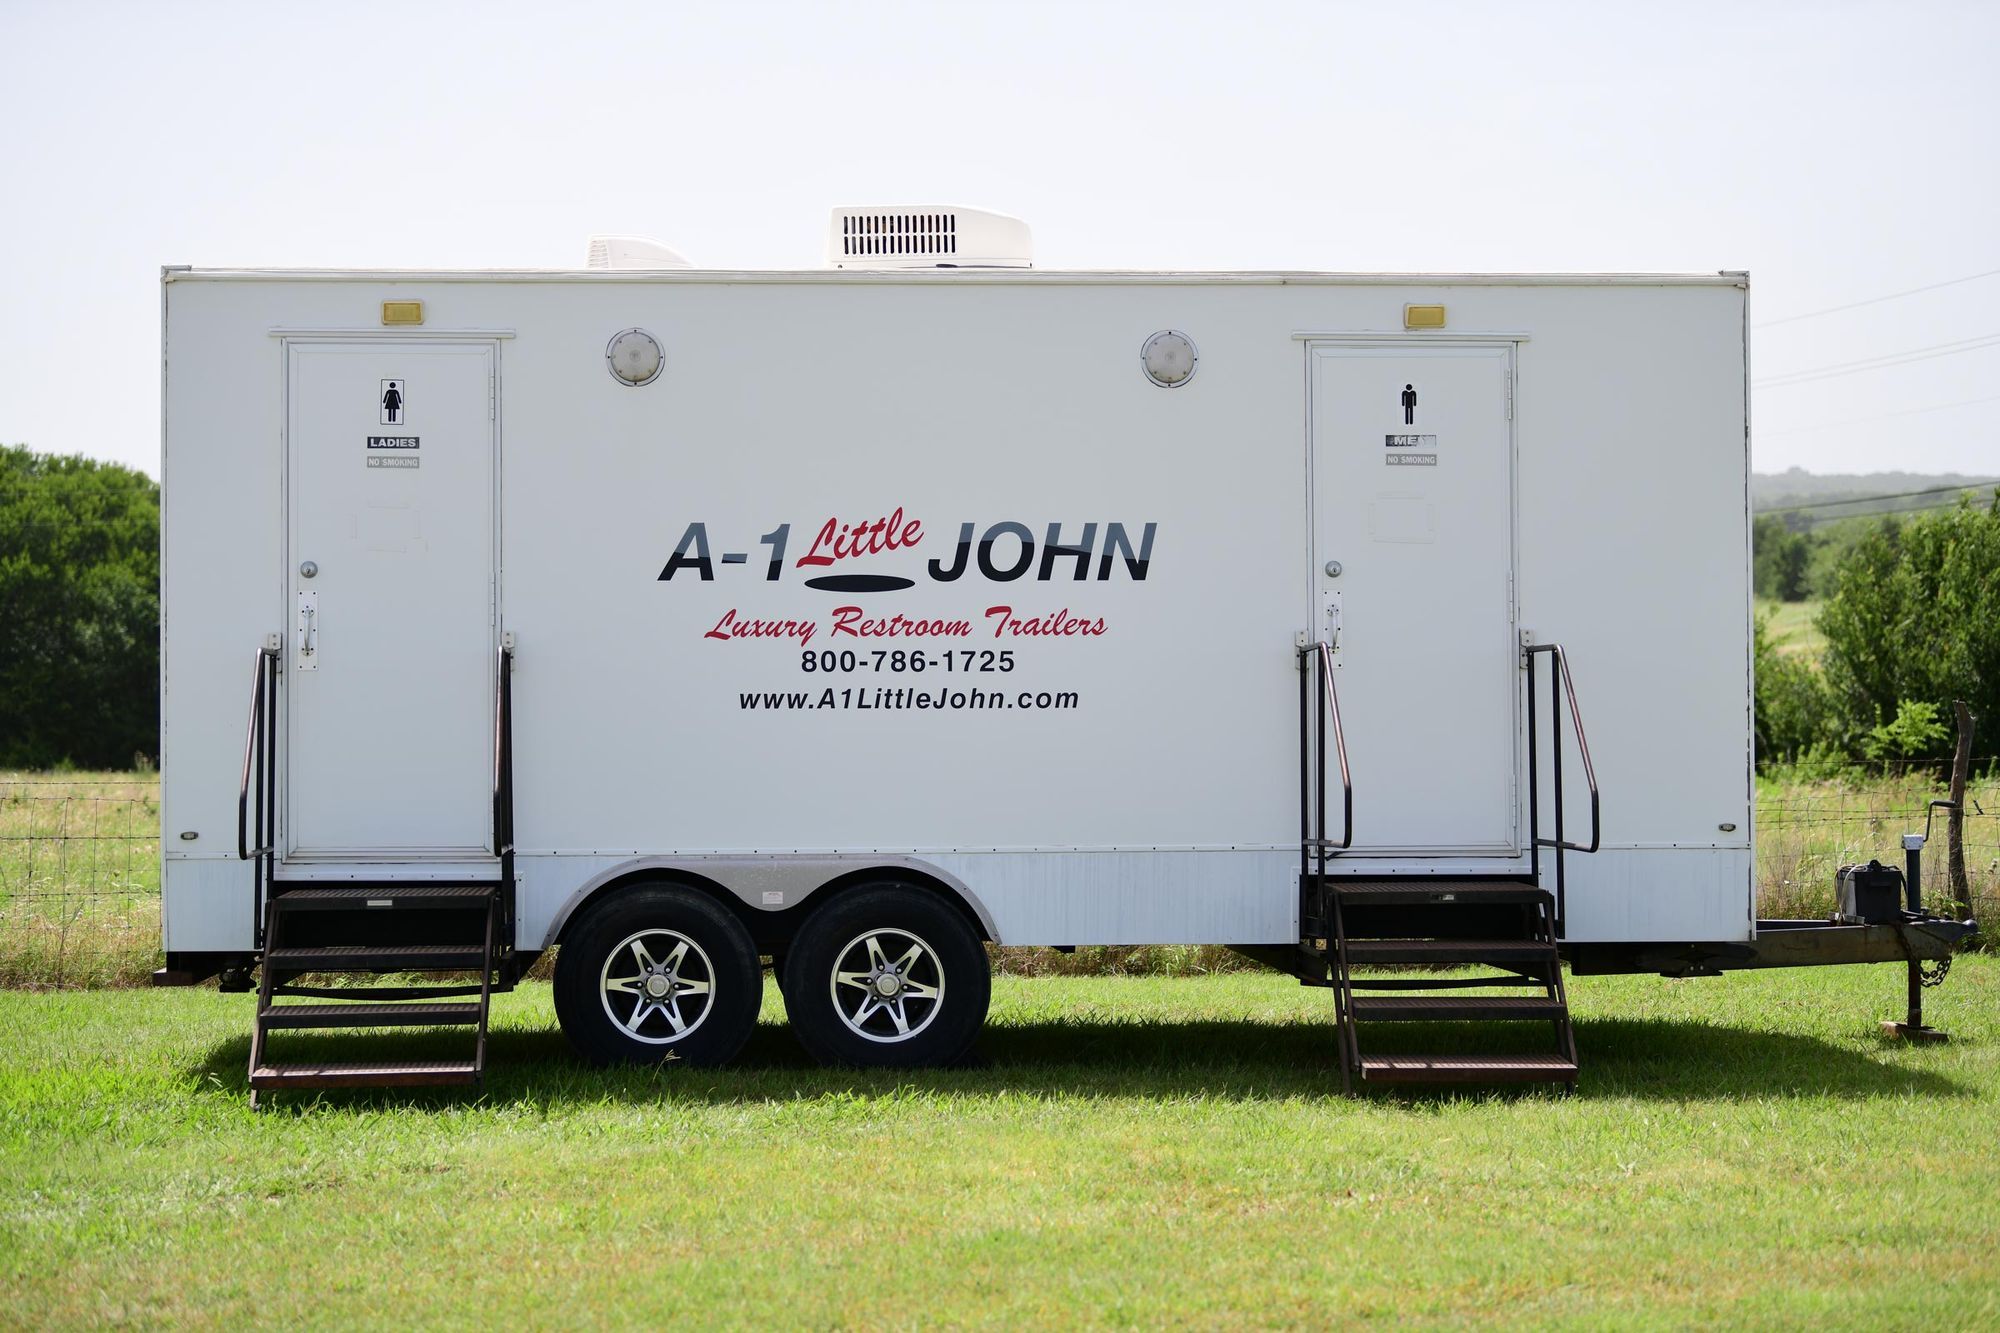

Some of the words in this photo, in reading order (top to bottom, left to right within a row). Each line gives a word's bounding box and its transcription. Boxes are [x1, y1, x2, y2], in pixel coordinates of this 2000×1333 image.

[370, 438, 416, 447] LADIES
[368, 458, 379, 467] NO
[382, 458, 418, 467] SMOKING
[1387, 455, 1398, 464] NO
[1400, 455, 1436, 464] SMOKING
[656, 522, 790, 581] A-1
[796, 507, 924, 569] Little
[928, 521, 1158, 582] JOHN
[704, 608, 817, 647] Luxury
[832, 606, 972, 638] Restroom
[985, 606, 1108, 638] Trailers
[801, 650, 1015, 673] 800-786-1725
[739, 687, 1079, 710] www.A1LittleJohn.com
